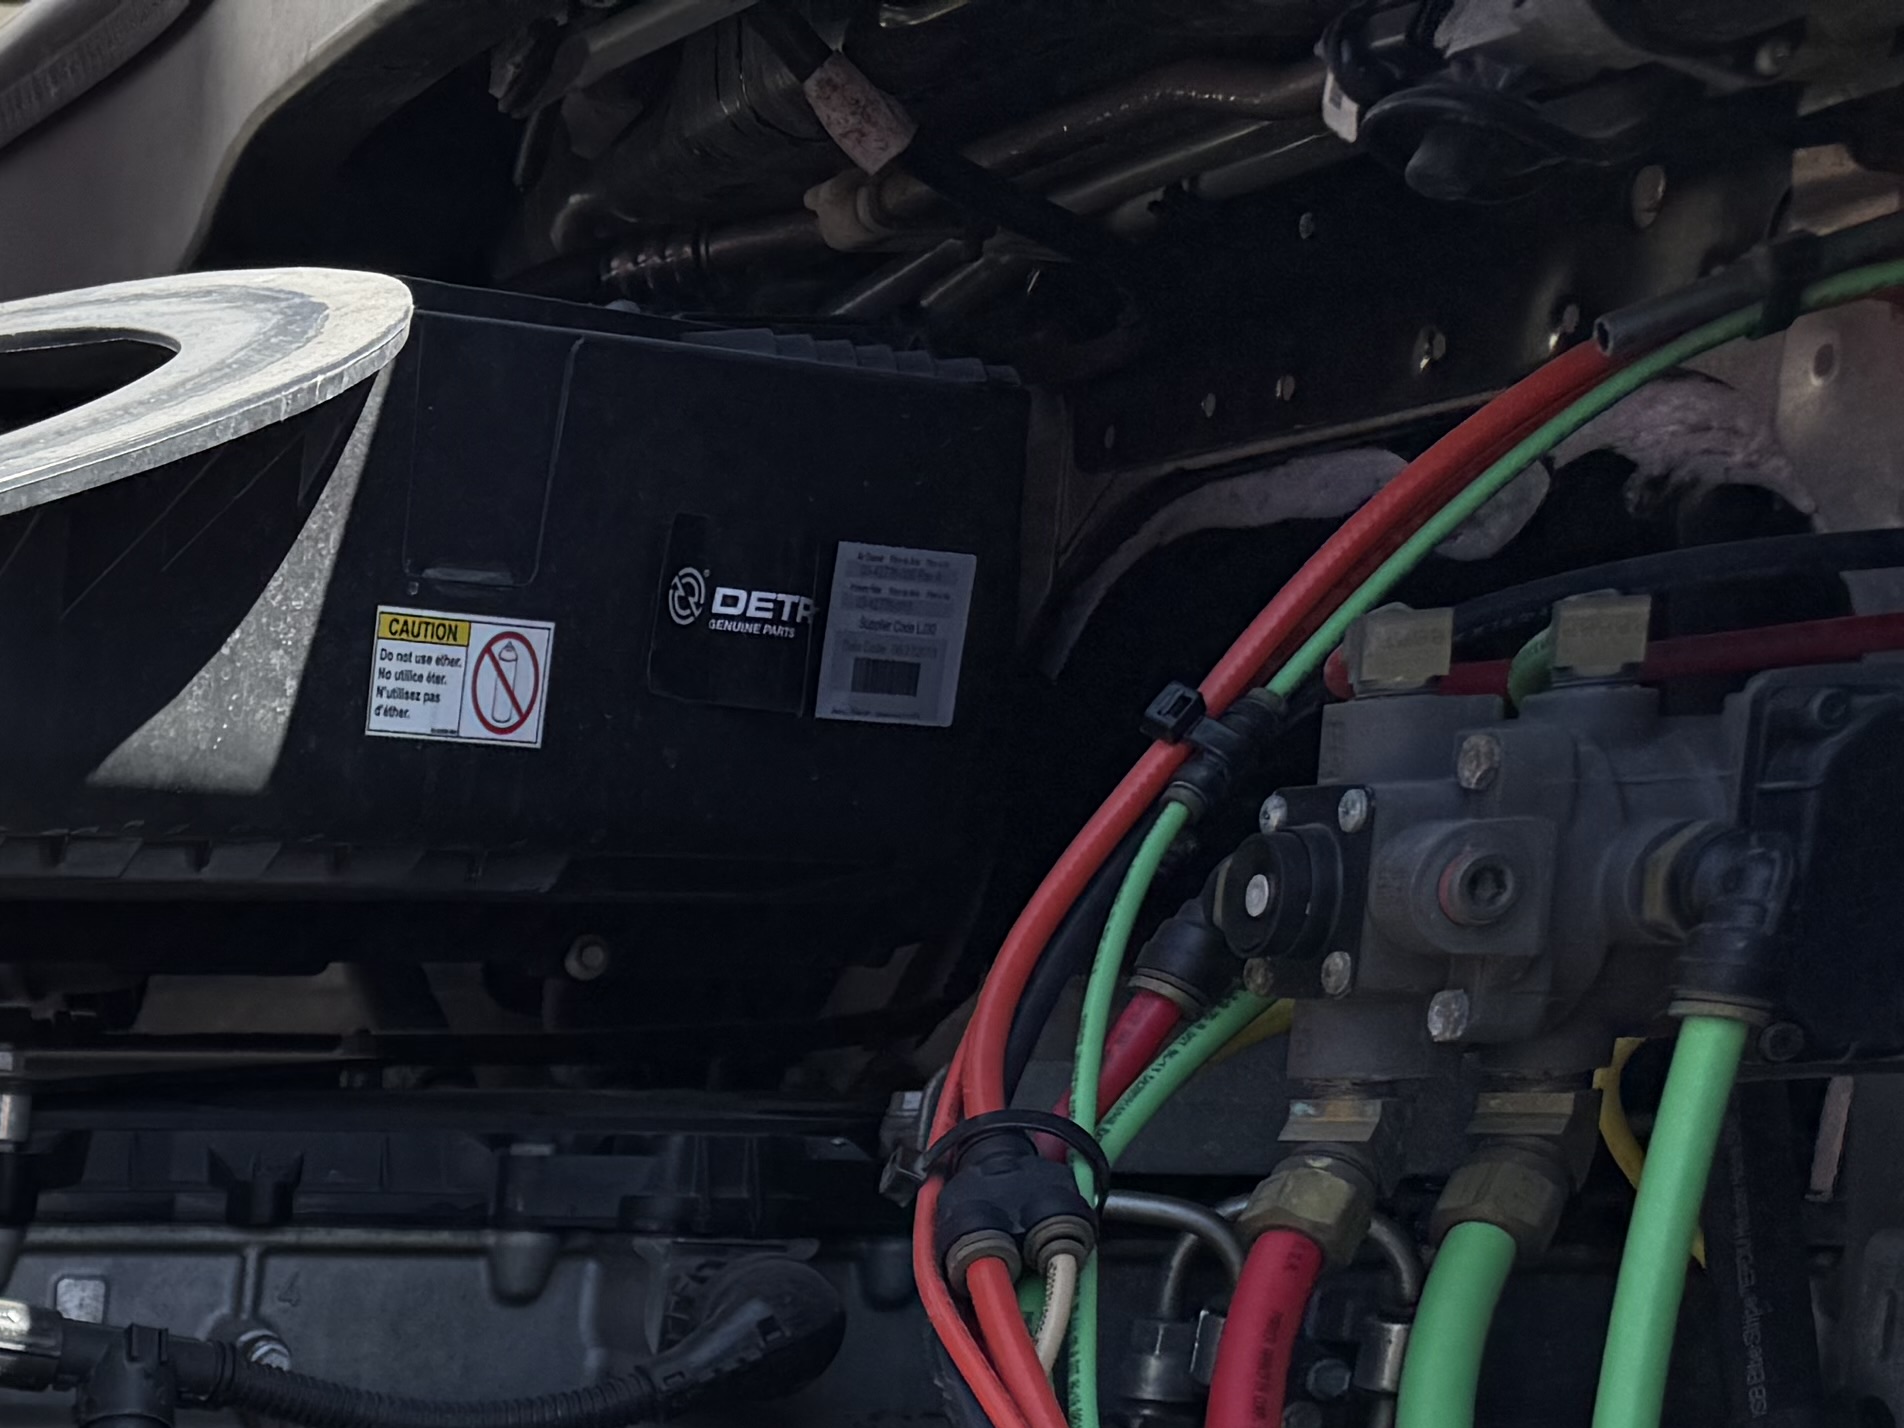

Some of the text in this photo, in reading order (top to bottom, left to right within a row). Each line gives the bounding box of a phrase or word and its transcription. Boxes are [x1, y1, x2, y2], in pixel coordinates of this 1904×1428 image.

[389, 618, 458, 642] CAUTION
[709, 620, 795, 638] GENUINE PARTS
[380, 648, 394, 661] Do
[396, 652, 412, 663] not
[415, 653, 432, 666] use
[378, 668, 392, 680] No
[423, 691, 441, 704] pas
